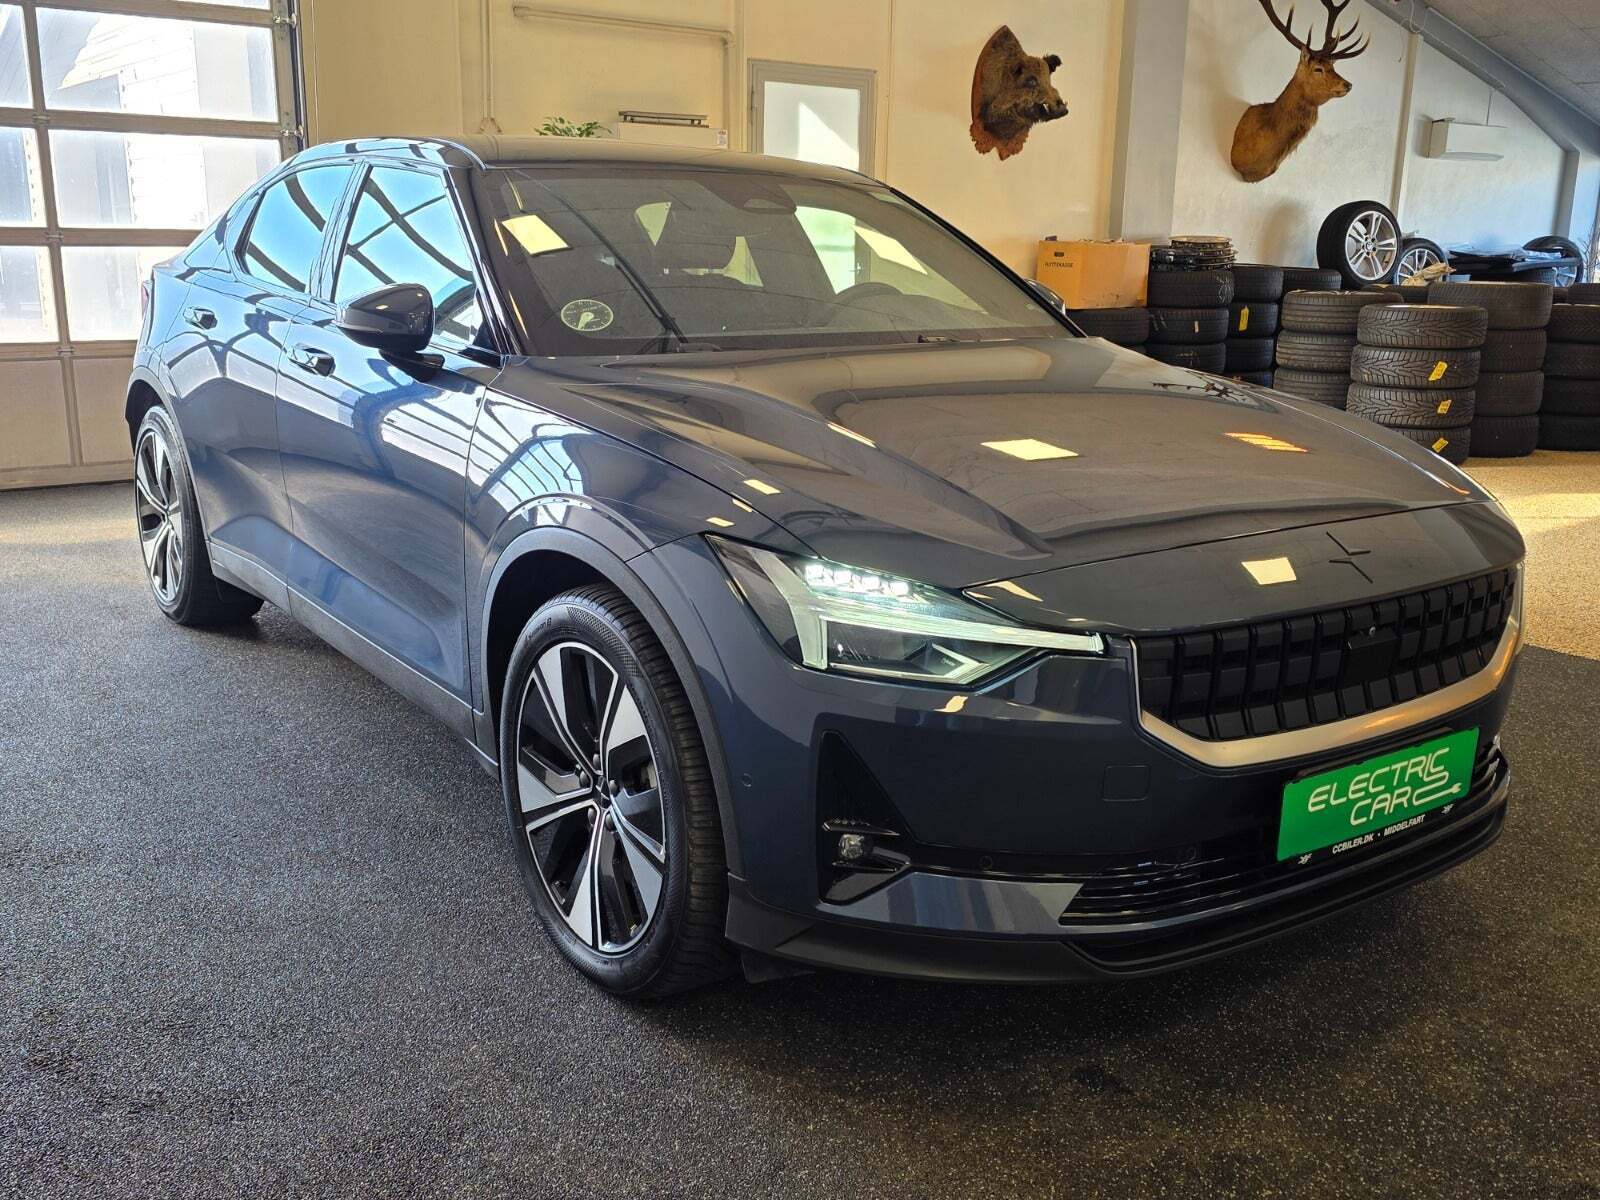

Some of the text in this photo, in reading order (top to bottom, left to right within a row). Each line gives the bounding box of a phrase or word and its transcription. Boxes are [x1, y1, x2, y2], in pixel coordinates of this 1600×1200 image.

[1308, 748, 1449, 813] ELECTRIC
[1332, 814, 1426, 854] CCBILER.DK MIDDELFART
